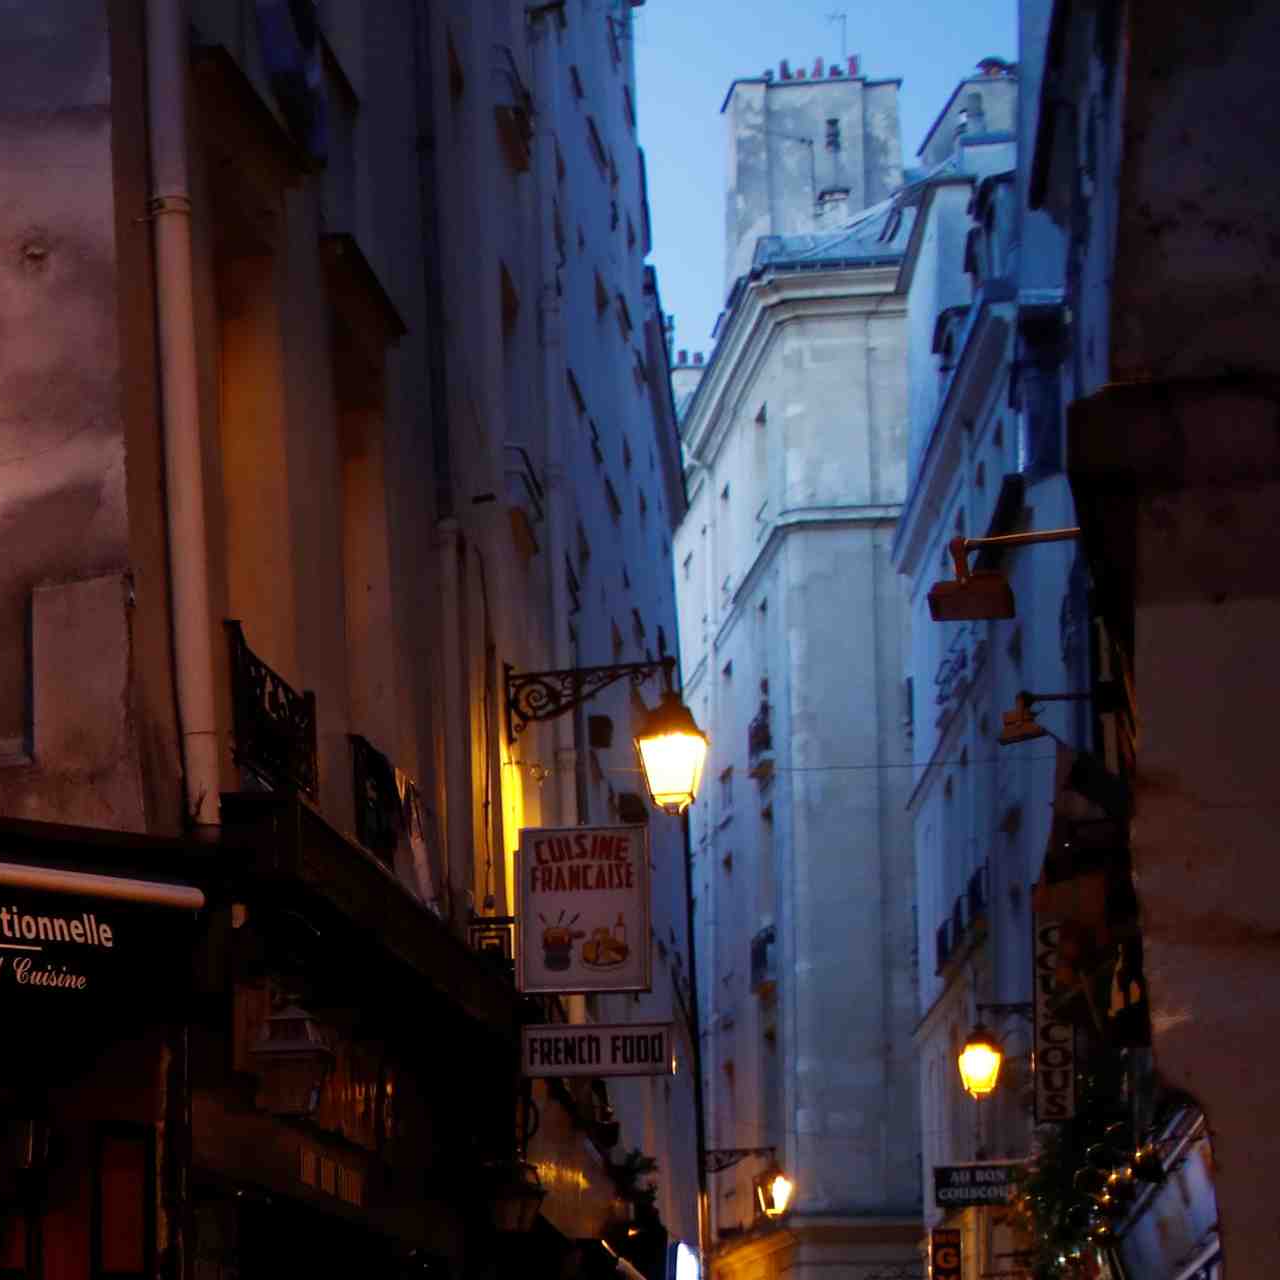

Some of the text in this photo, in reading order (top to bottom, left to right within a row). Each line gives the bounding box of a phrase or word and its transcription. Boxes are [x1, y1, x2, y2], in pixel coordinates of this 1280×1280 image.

[534, 834, 631, 865] CUISINE
[11, 956, 89, 990] Cuisine
[1038, 923, 1072, 1118] COUCOUS
